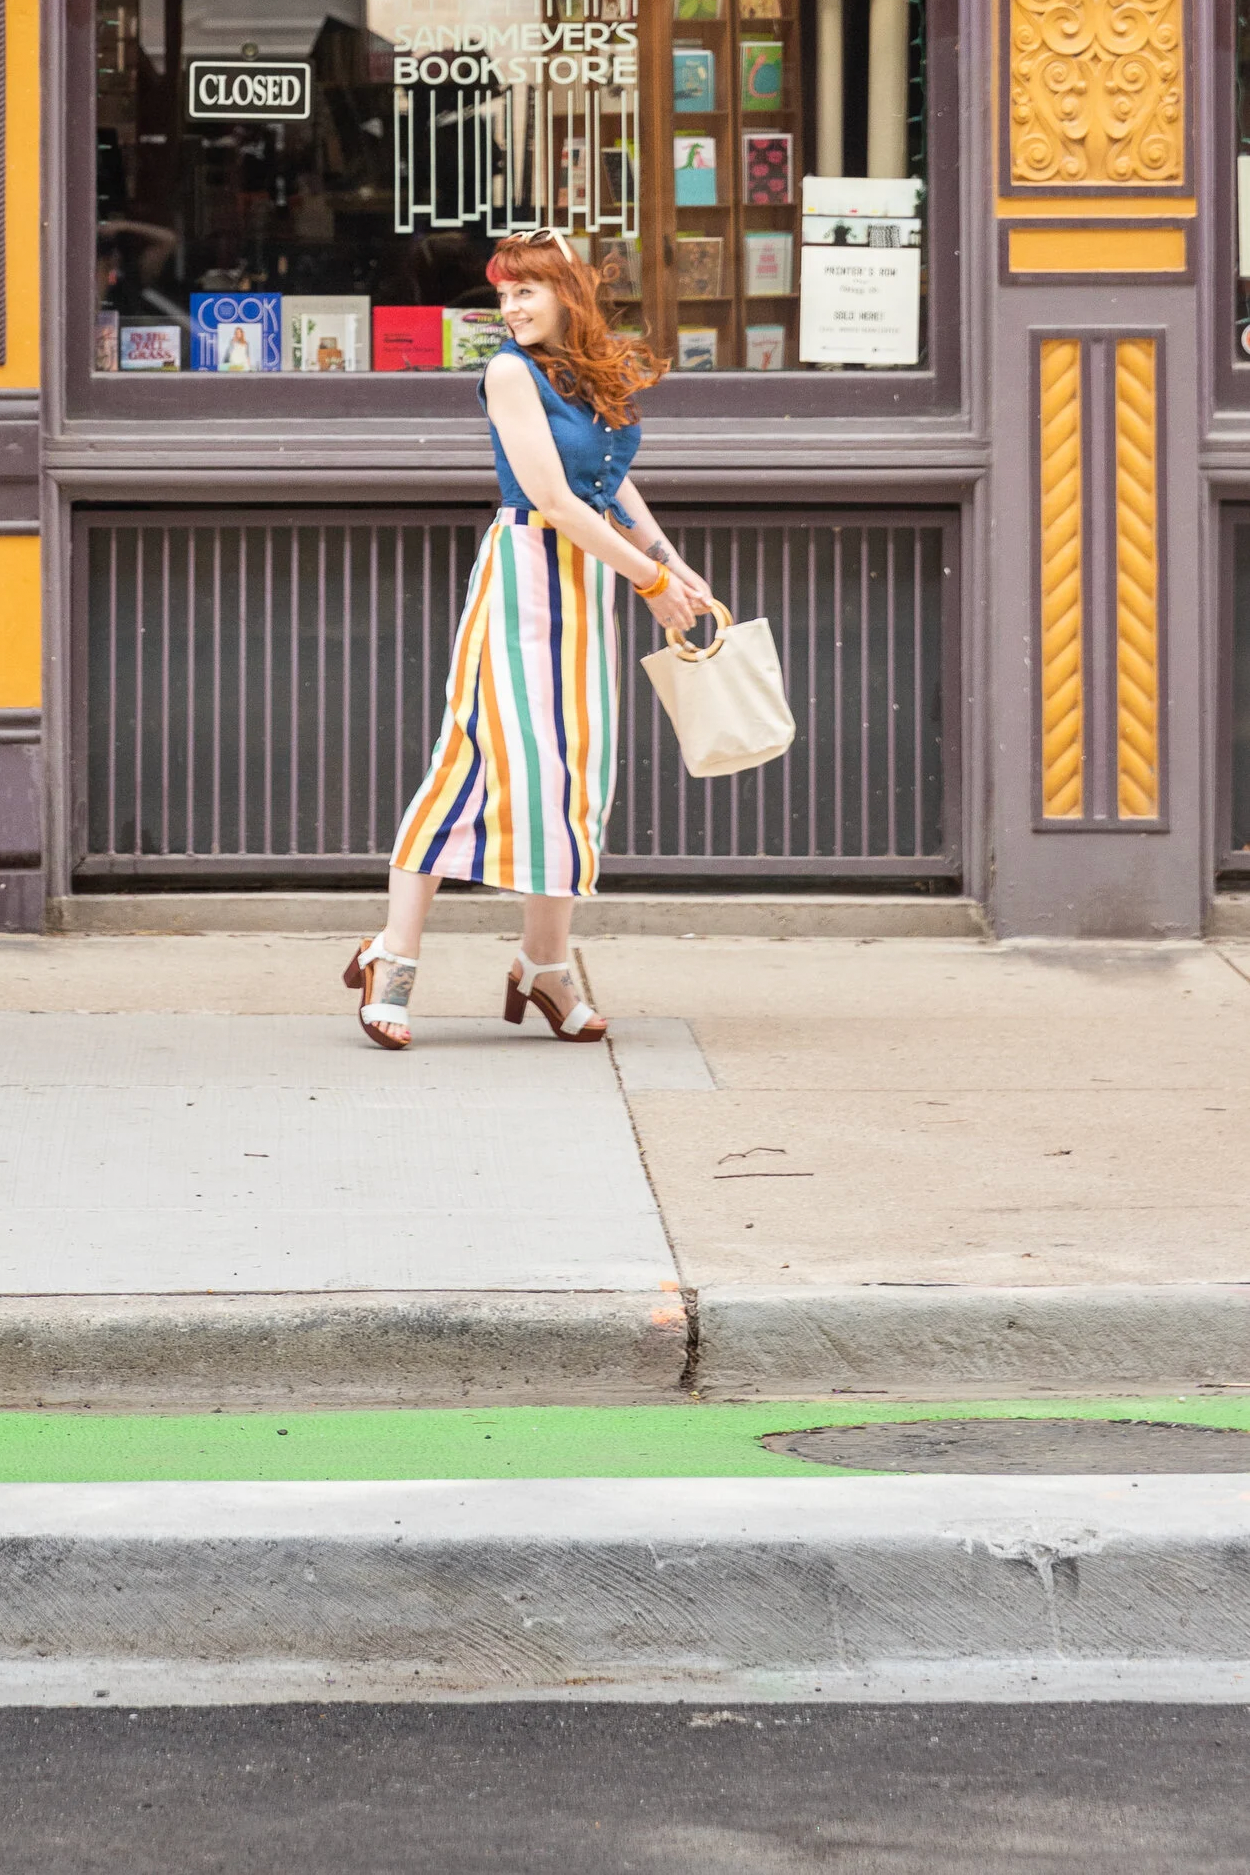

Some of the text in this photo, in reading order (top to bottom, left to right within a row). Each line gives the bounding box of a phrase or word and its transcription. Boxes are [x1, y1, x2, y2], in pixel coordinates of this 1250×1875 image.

[394, 22, 638, 52] SANDMEYER'S
[393, 56, 638, 85] BOOKSTORE
[198, 73, 301, 106] CLOSED
[824, 265, 897, 277] PRINTER'S ROW
[197, 296, 279, 333] COOK
[833, 310, 854, 321] SOLD
[128, 350, 172, 361] GRASS
